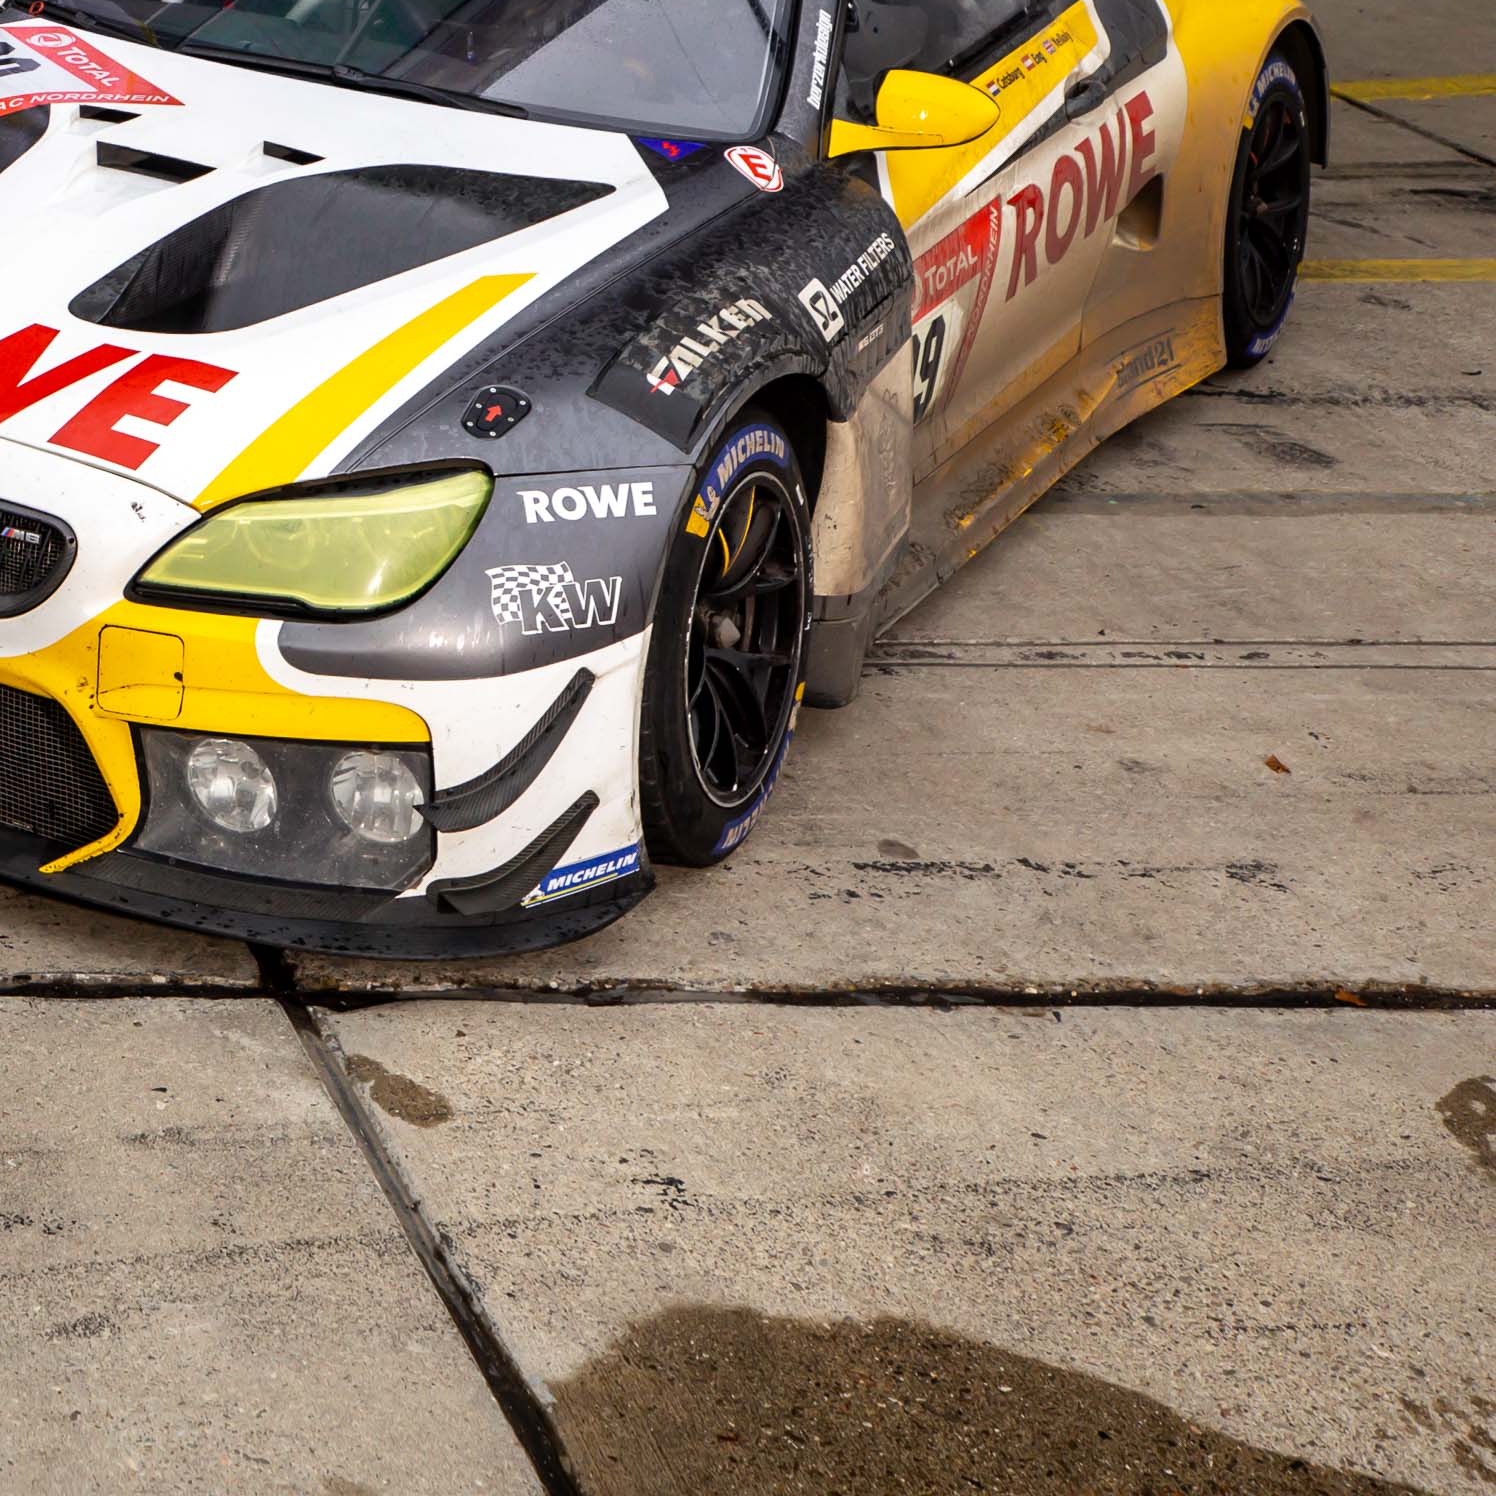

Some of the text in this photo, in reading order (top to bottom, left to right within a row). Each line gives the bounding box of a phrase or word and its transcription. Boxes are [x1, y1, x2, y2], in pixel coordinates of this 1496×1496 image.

[58, 46, 120, 87] TOTAL
[29, 91, 170, 104] NORDRHEIN
[1006, 89, 1161, 303] ROWE
[829, 232, 896, 304] WATER FILTERS
[924, 244, 979, 296] TOTAL
[716, 429, 786, 490] MICHELIN
[516, 480, 658, 525] ROWE
[518, 575, 623, 635] KW
[547, 852, 639, 894] MICHELIN
